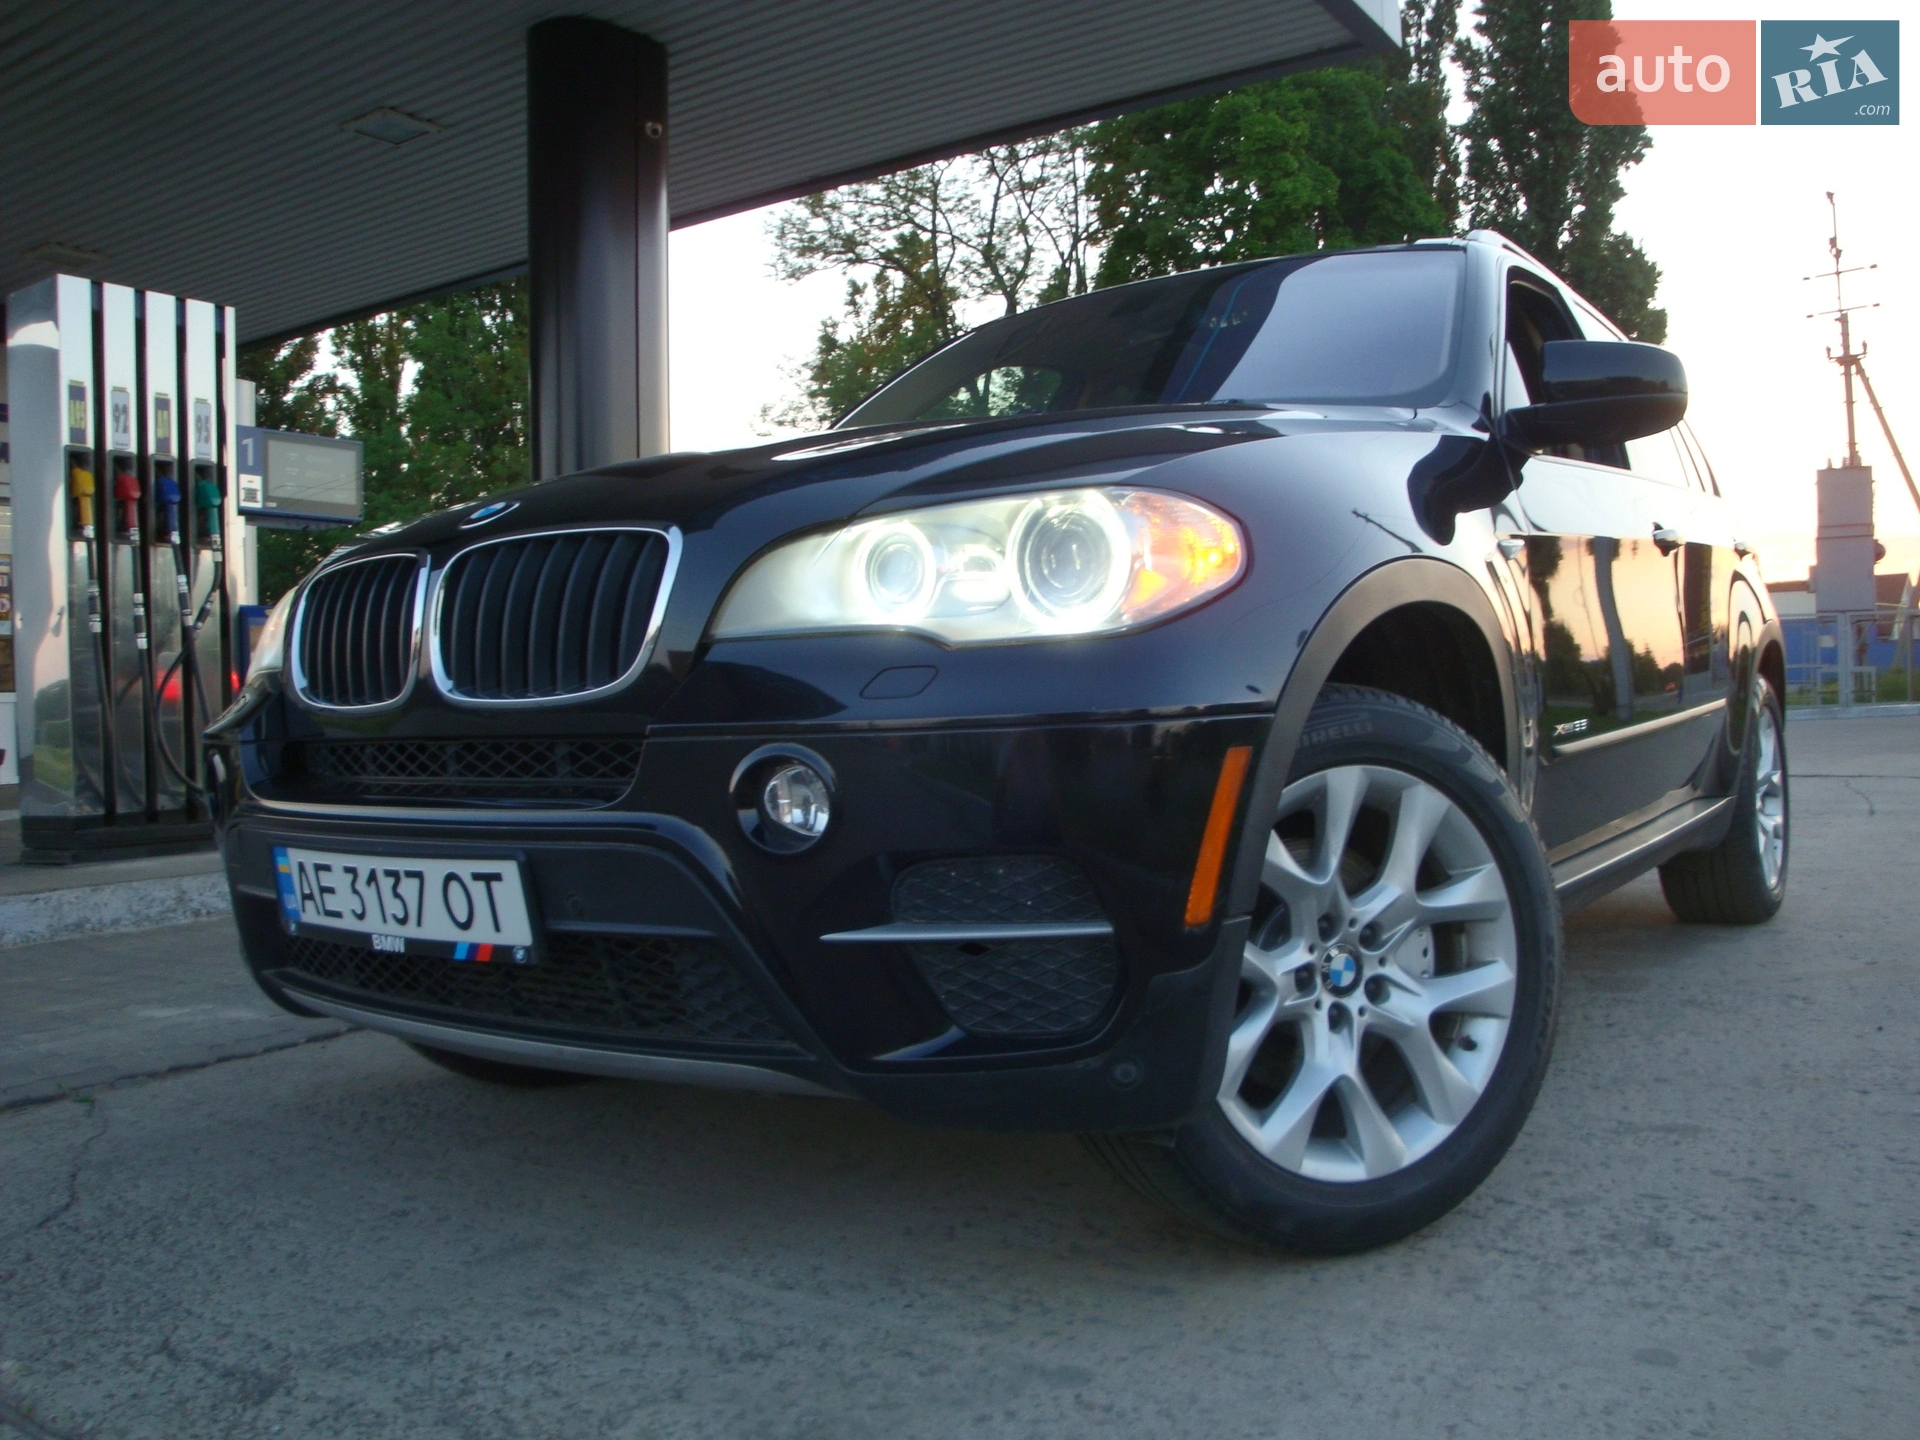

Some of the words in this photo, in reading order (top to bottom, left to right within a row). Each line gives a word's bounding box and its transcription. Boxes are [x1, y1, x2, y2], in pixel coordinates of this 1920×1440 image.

[241, 438, 254, 466] 1
[1300, 713, 1373, 747] IRELLI
[442, 870, 503, 933] OT
[371, 933, 406, 953] BMW
